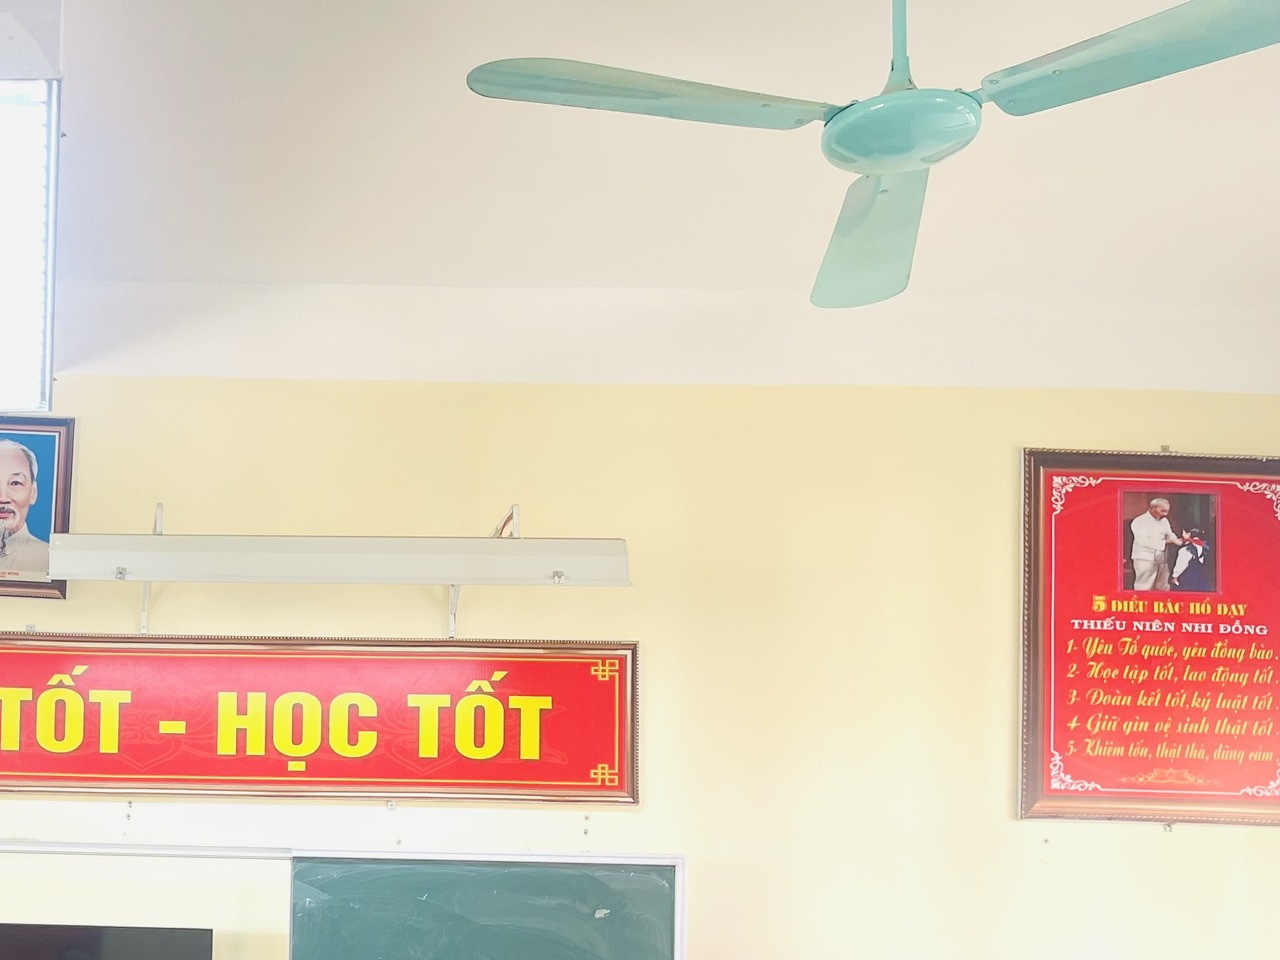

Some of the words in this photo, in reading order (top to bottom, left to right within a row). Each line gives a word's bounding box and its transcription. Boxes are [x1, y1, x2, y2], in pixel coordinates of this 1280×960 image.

[1092, 595, 1107, 613] 5
[1153, 599, 1184, 614] BÁC
[1189, 597, 1212, 614] HỒ
[1217, 603, 1247, 618] DẠY
[1071, 616, 1127, 630] THIẾU
[1133, 620, 1175, 632] NIÊN
[1181, 622, 1213, 633] NHI
[1218, 620, 1268, 635] ĐỒNG
[1082, 637, 1113, 658] Yêu
[1142, 638, 1178, 661] quốc,
[1182, 642, 1207, 660] yêu
[1211, 639, 1246, 662] đồng
[1086, 661, 1119, 684] Học
[1123, 665, 1149, 684] tập
[1153, 662, 1178, 683] tốt,
[1183, 665, 1207, 681] lao
[1211, 665, 1248, 687] động
[1086, 688, 1131, 706] Đoàn
[1137, 689, 1161, 707] kết
[1216, 693, 1248, 713] luật
[216, 690, 378, 772] HỌC
[407, 670, 553, 760] TỐT
[1123, 716, 1149, 735] gìn
[1154, 717, 1172, 737] vệ
[1176, 716, 1209, 734] sinh
[1214, 717, 1248, 739] thật
[1084, 738, 1124, 757] Khiêm
[1156, 742, 1182, 762] thật
